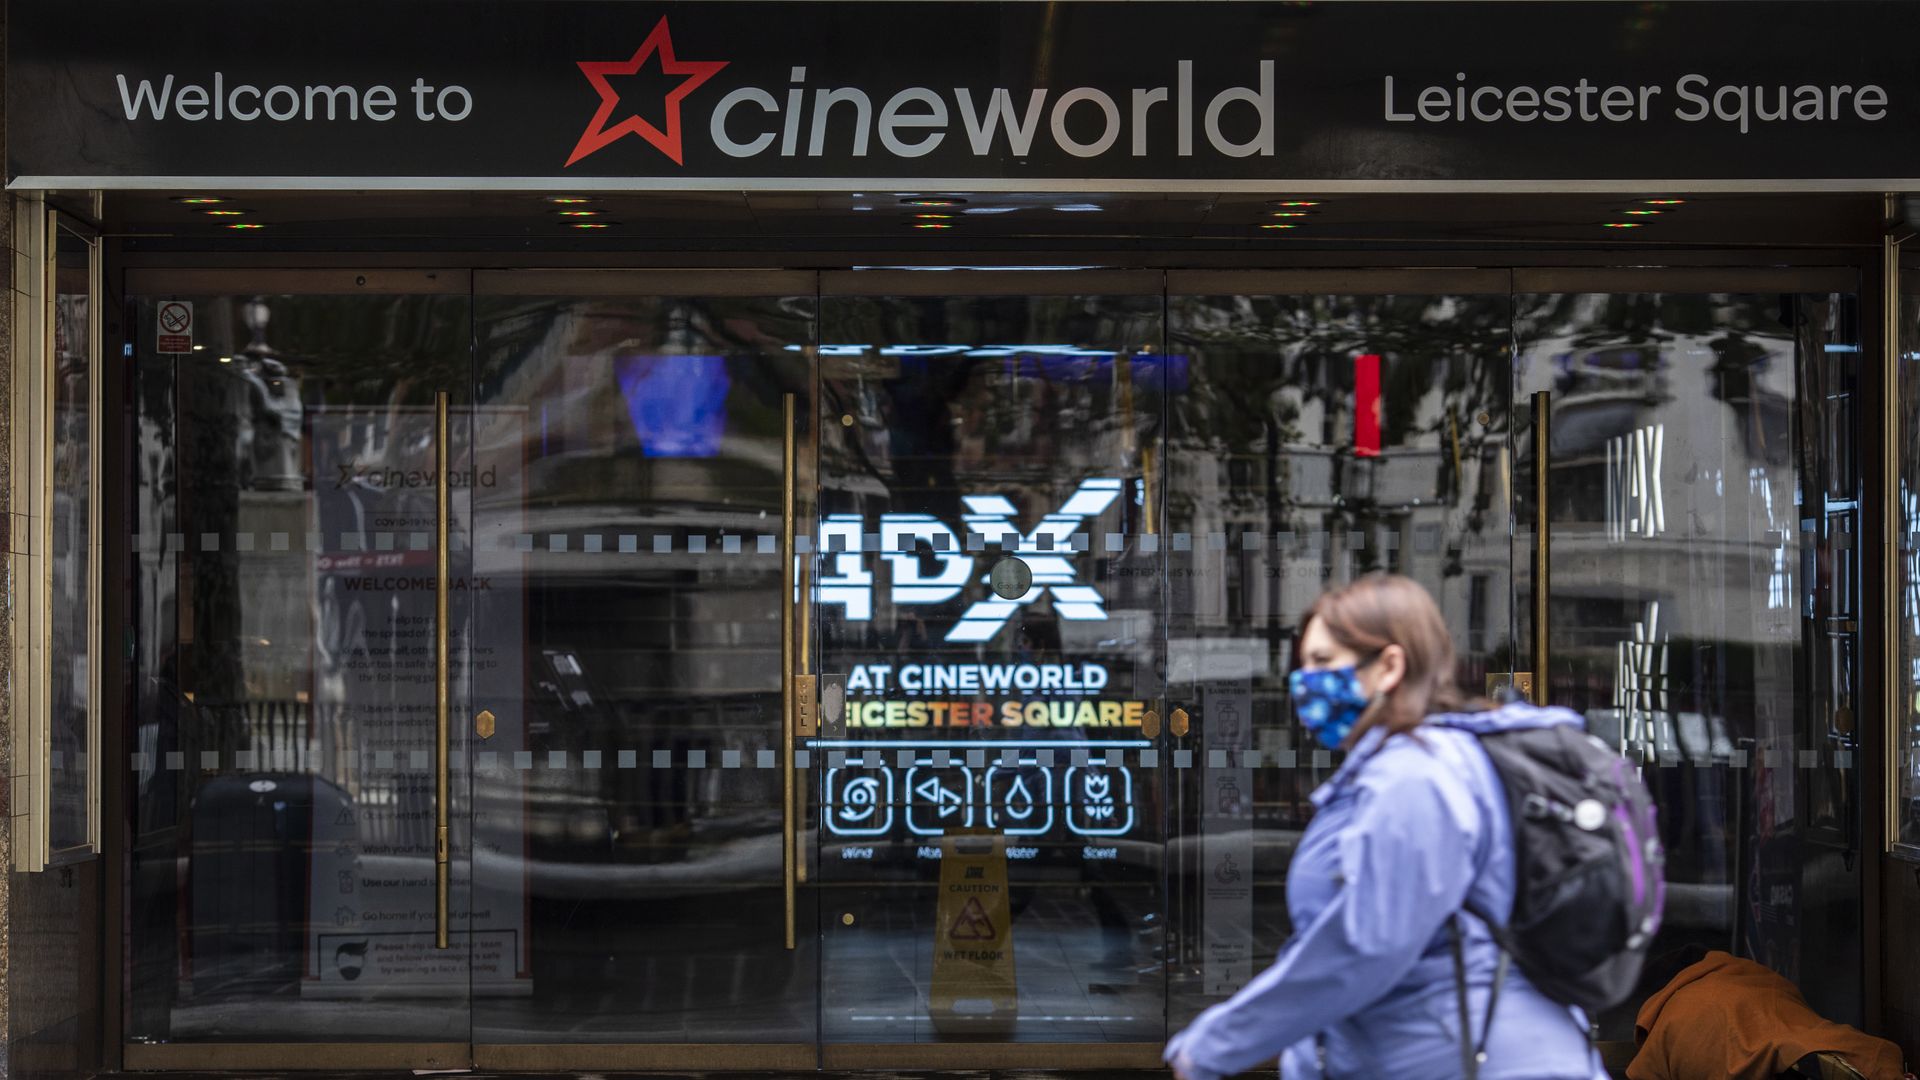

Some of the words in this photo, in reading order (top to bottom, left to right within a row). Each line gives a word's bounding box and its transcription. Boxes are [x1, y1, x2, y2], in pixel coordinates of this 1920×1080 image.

[116, 71, 397, 122] Welcome
[410, 77, 473, 122] to
[710, 60, 1275, 158] cineworld
[1385, 74, 1661, 122] Leicester
[1675, 74, 1888, 134] Square
[795, 478, 1122, 641] 4DX
[344, 577, 436, 590] WELCOME
[847, 665, 891, 690] AT
[900, 664, 1108, 690] CINEWORLD
[1001, 700, 1144, 728] SQUARE
[948, 884, 1000, 893] CAUTION
